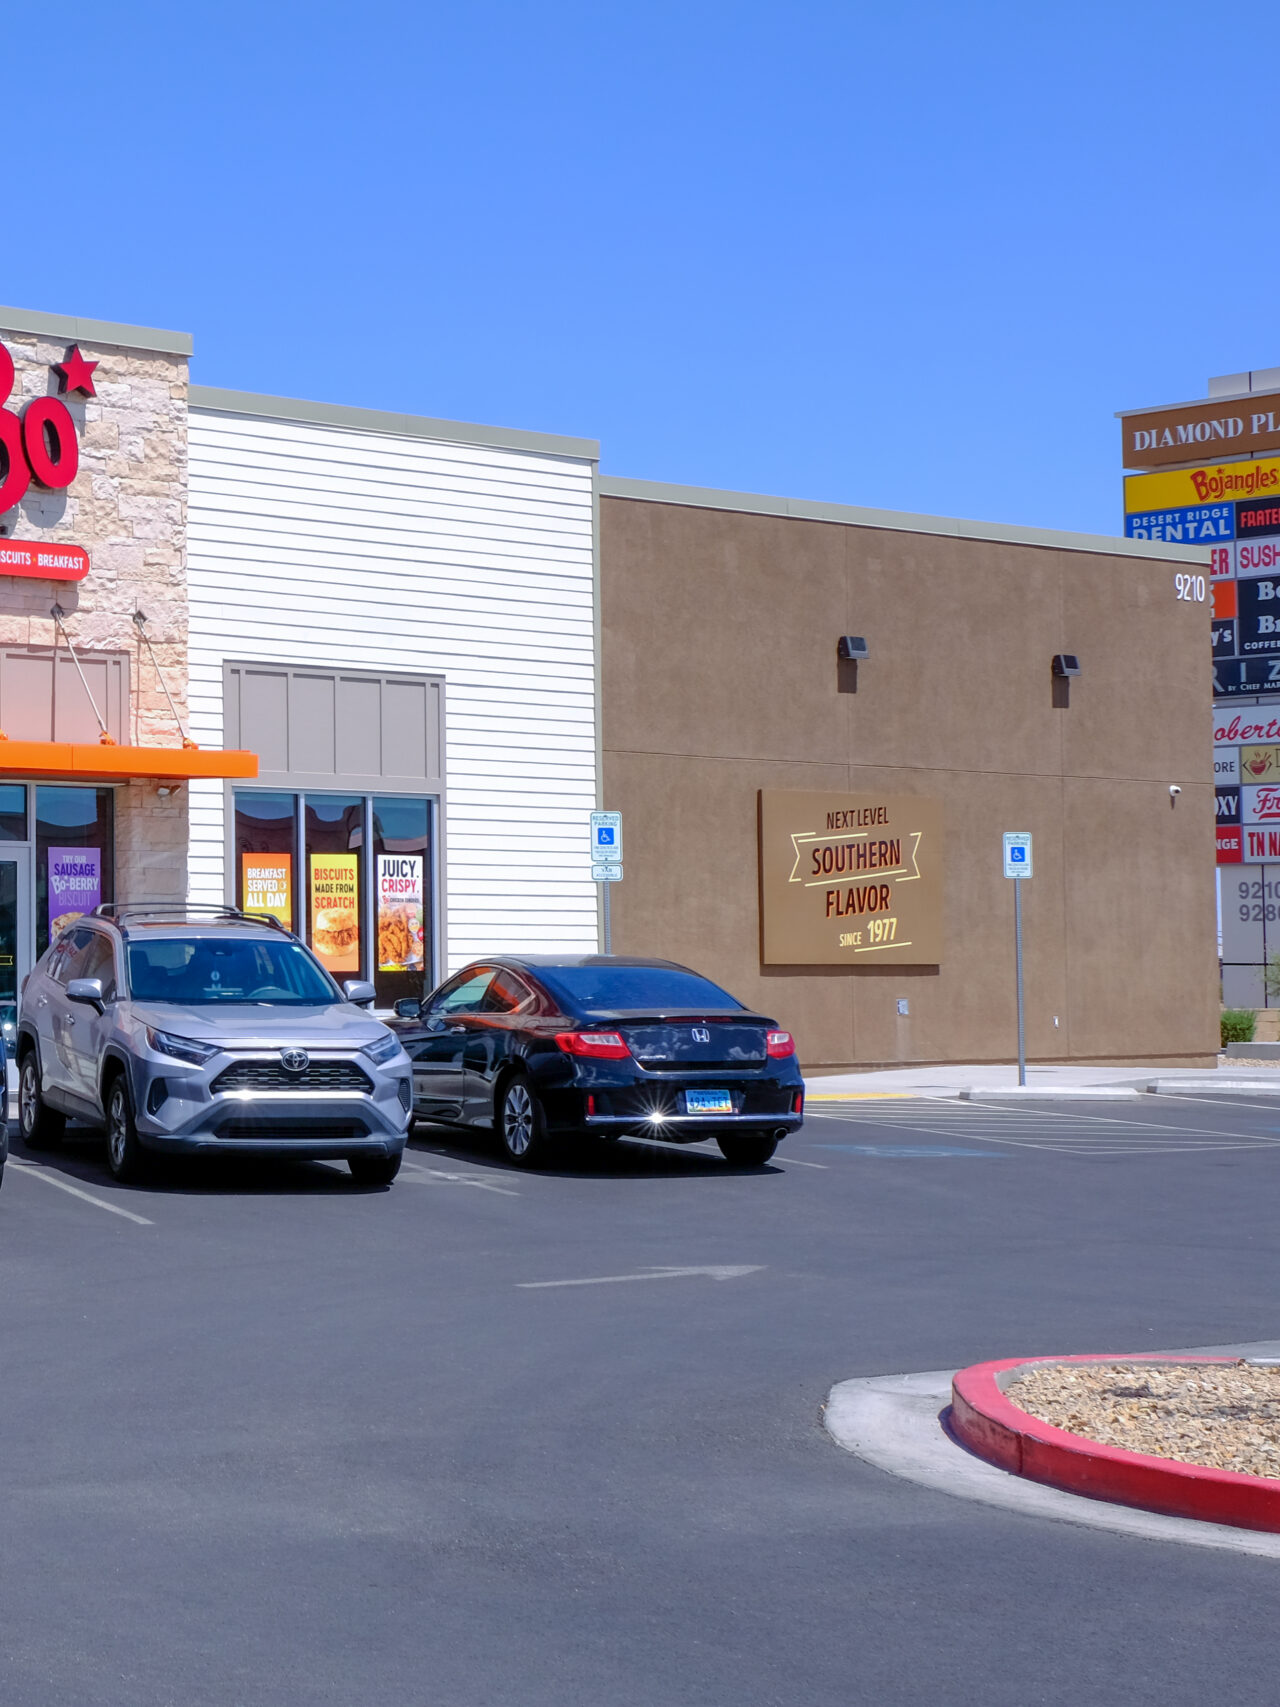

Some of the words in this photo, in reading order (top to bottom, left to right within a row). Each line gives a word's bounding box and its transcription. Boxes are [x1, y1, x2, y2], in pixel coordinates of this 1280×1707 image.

[1133, 417, 1244, 451] DIAMOND
[1250, 412, 1280, 435] PL
[1190, 466, 1279, 502] Bojangles
[1132, 513, 1181, 527] DESERT
[1187, 508, 1229, 521] RIDGE
[1240, 508, 1280, 528] FRATE
[1133, 519, 1230, 541] DENTAL
[37, 553, 84, 570] BREAKFAST
[1239, 544, 1280, 569] SUSH
[1175, 573, 1206, 602] 9210
[1214, 761, 1235, 773] ORE
[826, 810, 856, 830] NEXT
[857, 806, 889, 827] LEVEL
[1248, 832, 1265, 856] TN
[62, 855, 74, 863] TRY
[812, 838, 902, 876] SOUTHERN
[54, 863, 96, 876] SAUSAGE
[247, 868, 287, 879] BREAKFAST
[314, 868, 354, 881] BISCUITS
[381, 859, 419, 878] JUICY.
[247, 880, 278, 892] SERVED
[315, 883, 334, 893] MADE
[335, 883, 354, 893] FROM
[381, 879, 419, 893] CRISPY.
[59, 892, 91, 906] BISCUIT
[246, 893, 264, 907] ALL
[266, 893, 287, 907] DAY
[314, 896, 355, 909] SCRATCH
[826, 884, 891, 918] FLAVOR
[1239, 904, 1280, 922] 928
[839, 931, 862, 947] SINCE
[867, 917, 897, 943] 1977
